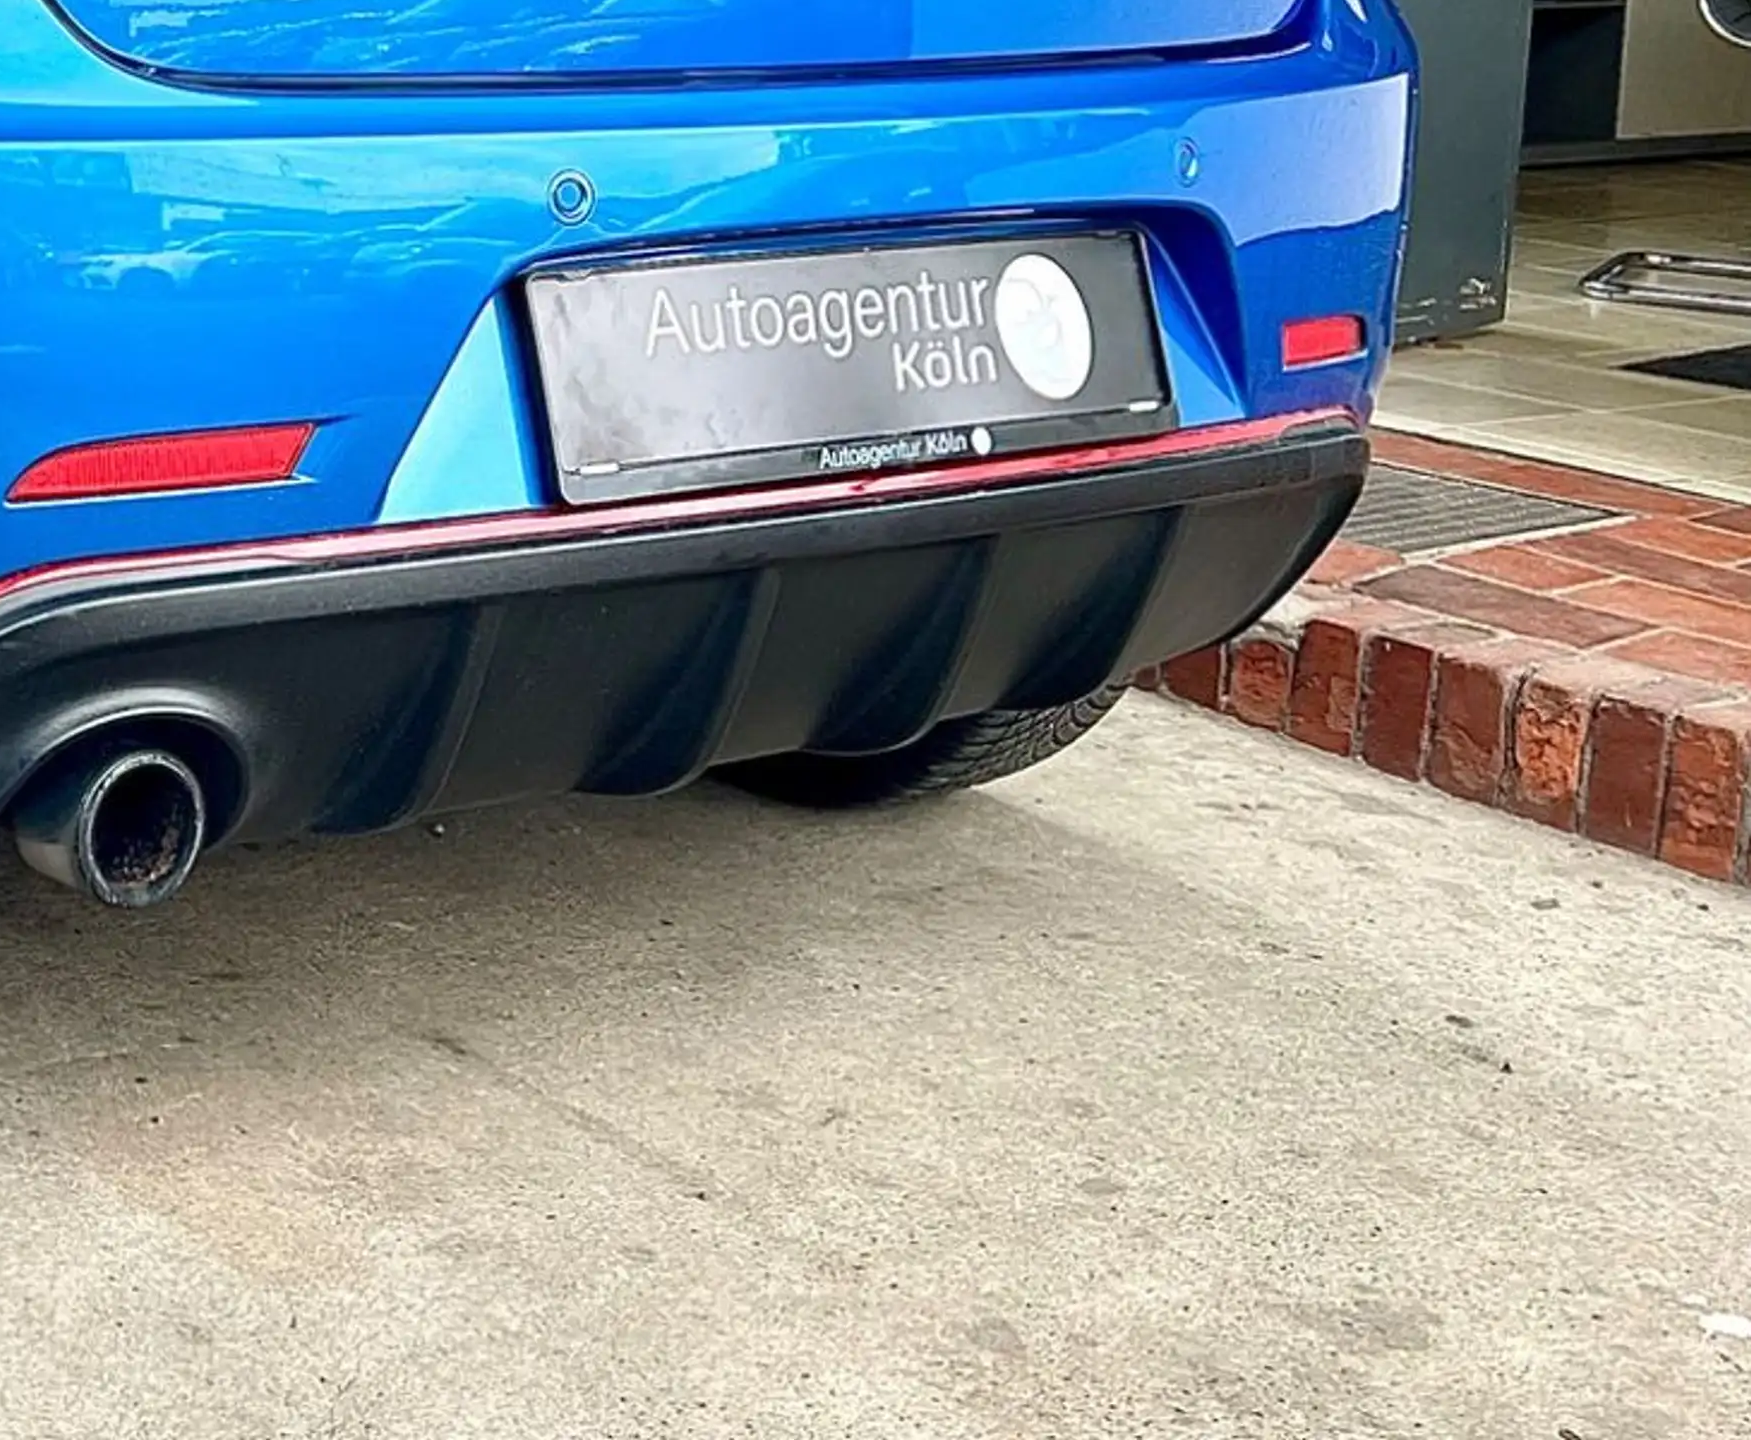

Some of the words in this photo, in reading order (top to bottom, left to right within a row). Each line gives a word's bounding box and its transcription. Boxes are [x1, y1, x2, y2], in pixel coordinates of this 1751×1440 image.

[646, 270, 992, 360] Autoagentur
[893, 336, 998, 394] Köln
[818, 437, 923, 471] Autoagentur
[924, 431, 969, 454] Köln
